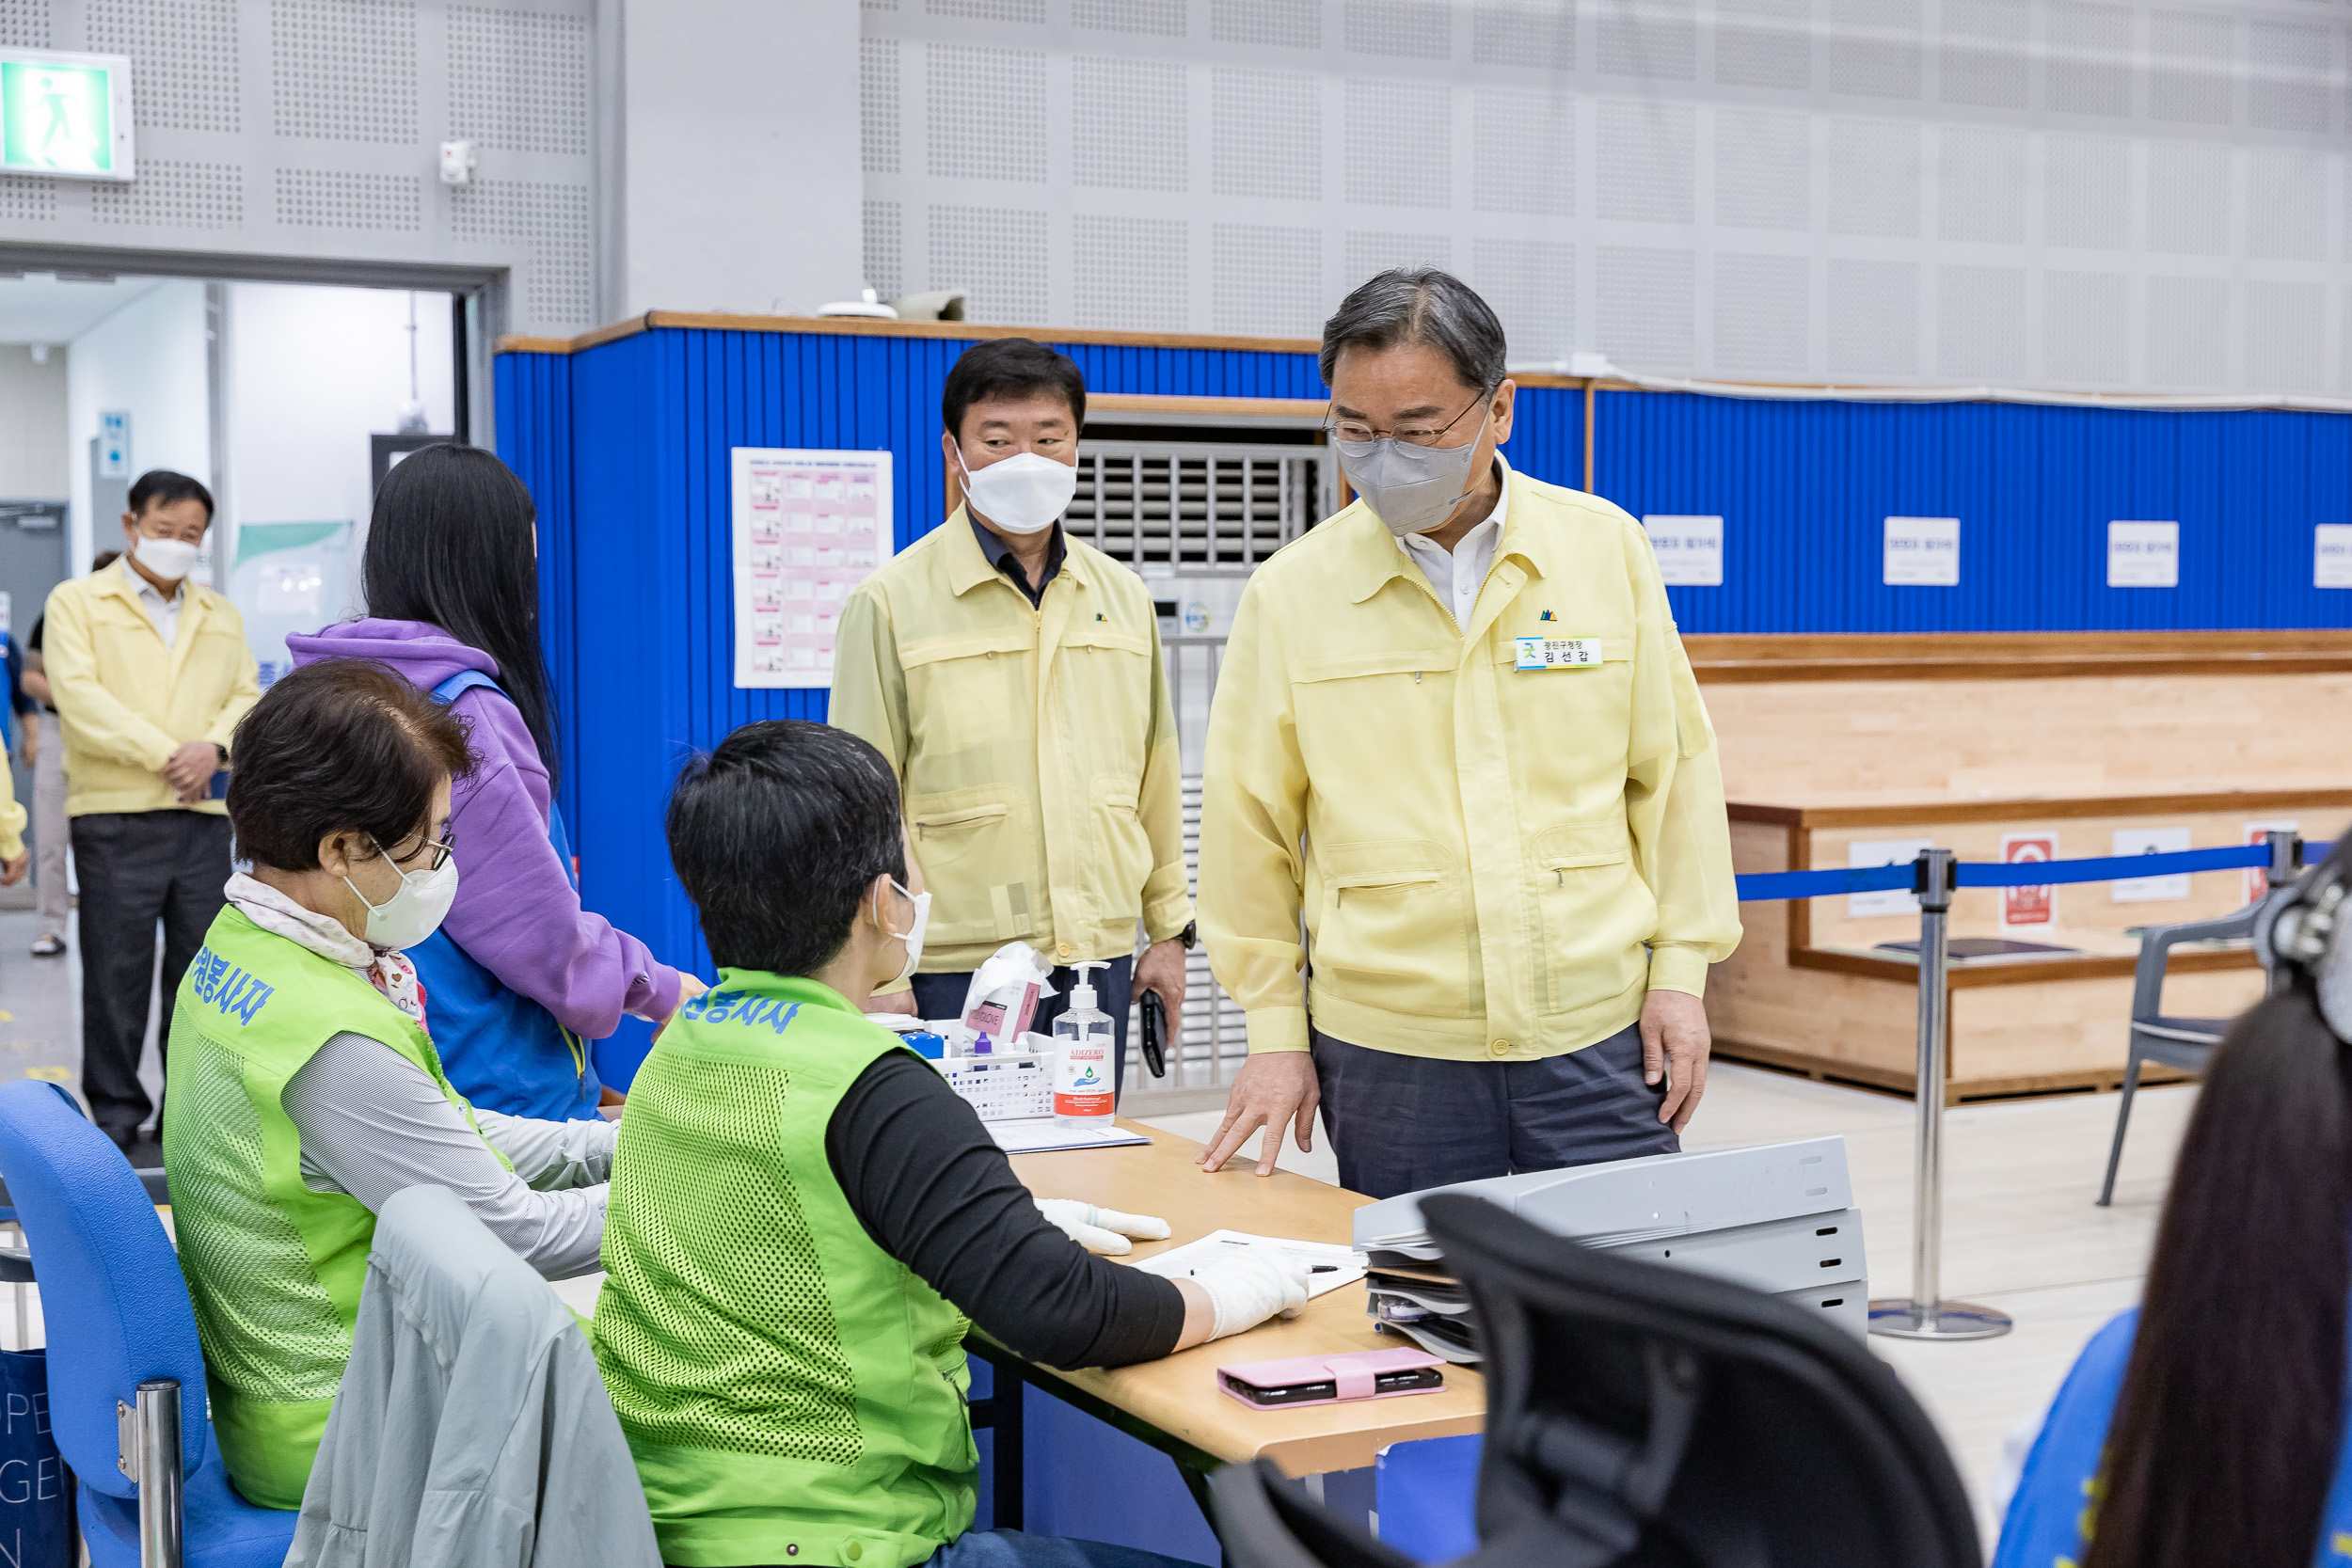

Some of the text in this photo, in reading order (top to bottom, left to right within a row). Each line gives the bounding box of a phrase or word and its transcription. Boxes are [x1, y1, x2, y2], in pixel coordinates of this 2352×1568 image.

[1543, 641, 1583, 652] 광진구청장
[190, 945, 276, 1027] 원봉사자
[680, 988, 803, 1035] 원봉사자
[0, 1391, 52, 1435] PE
